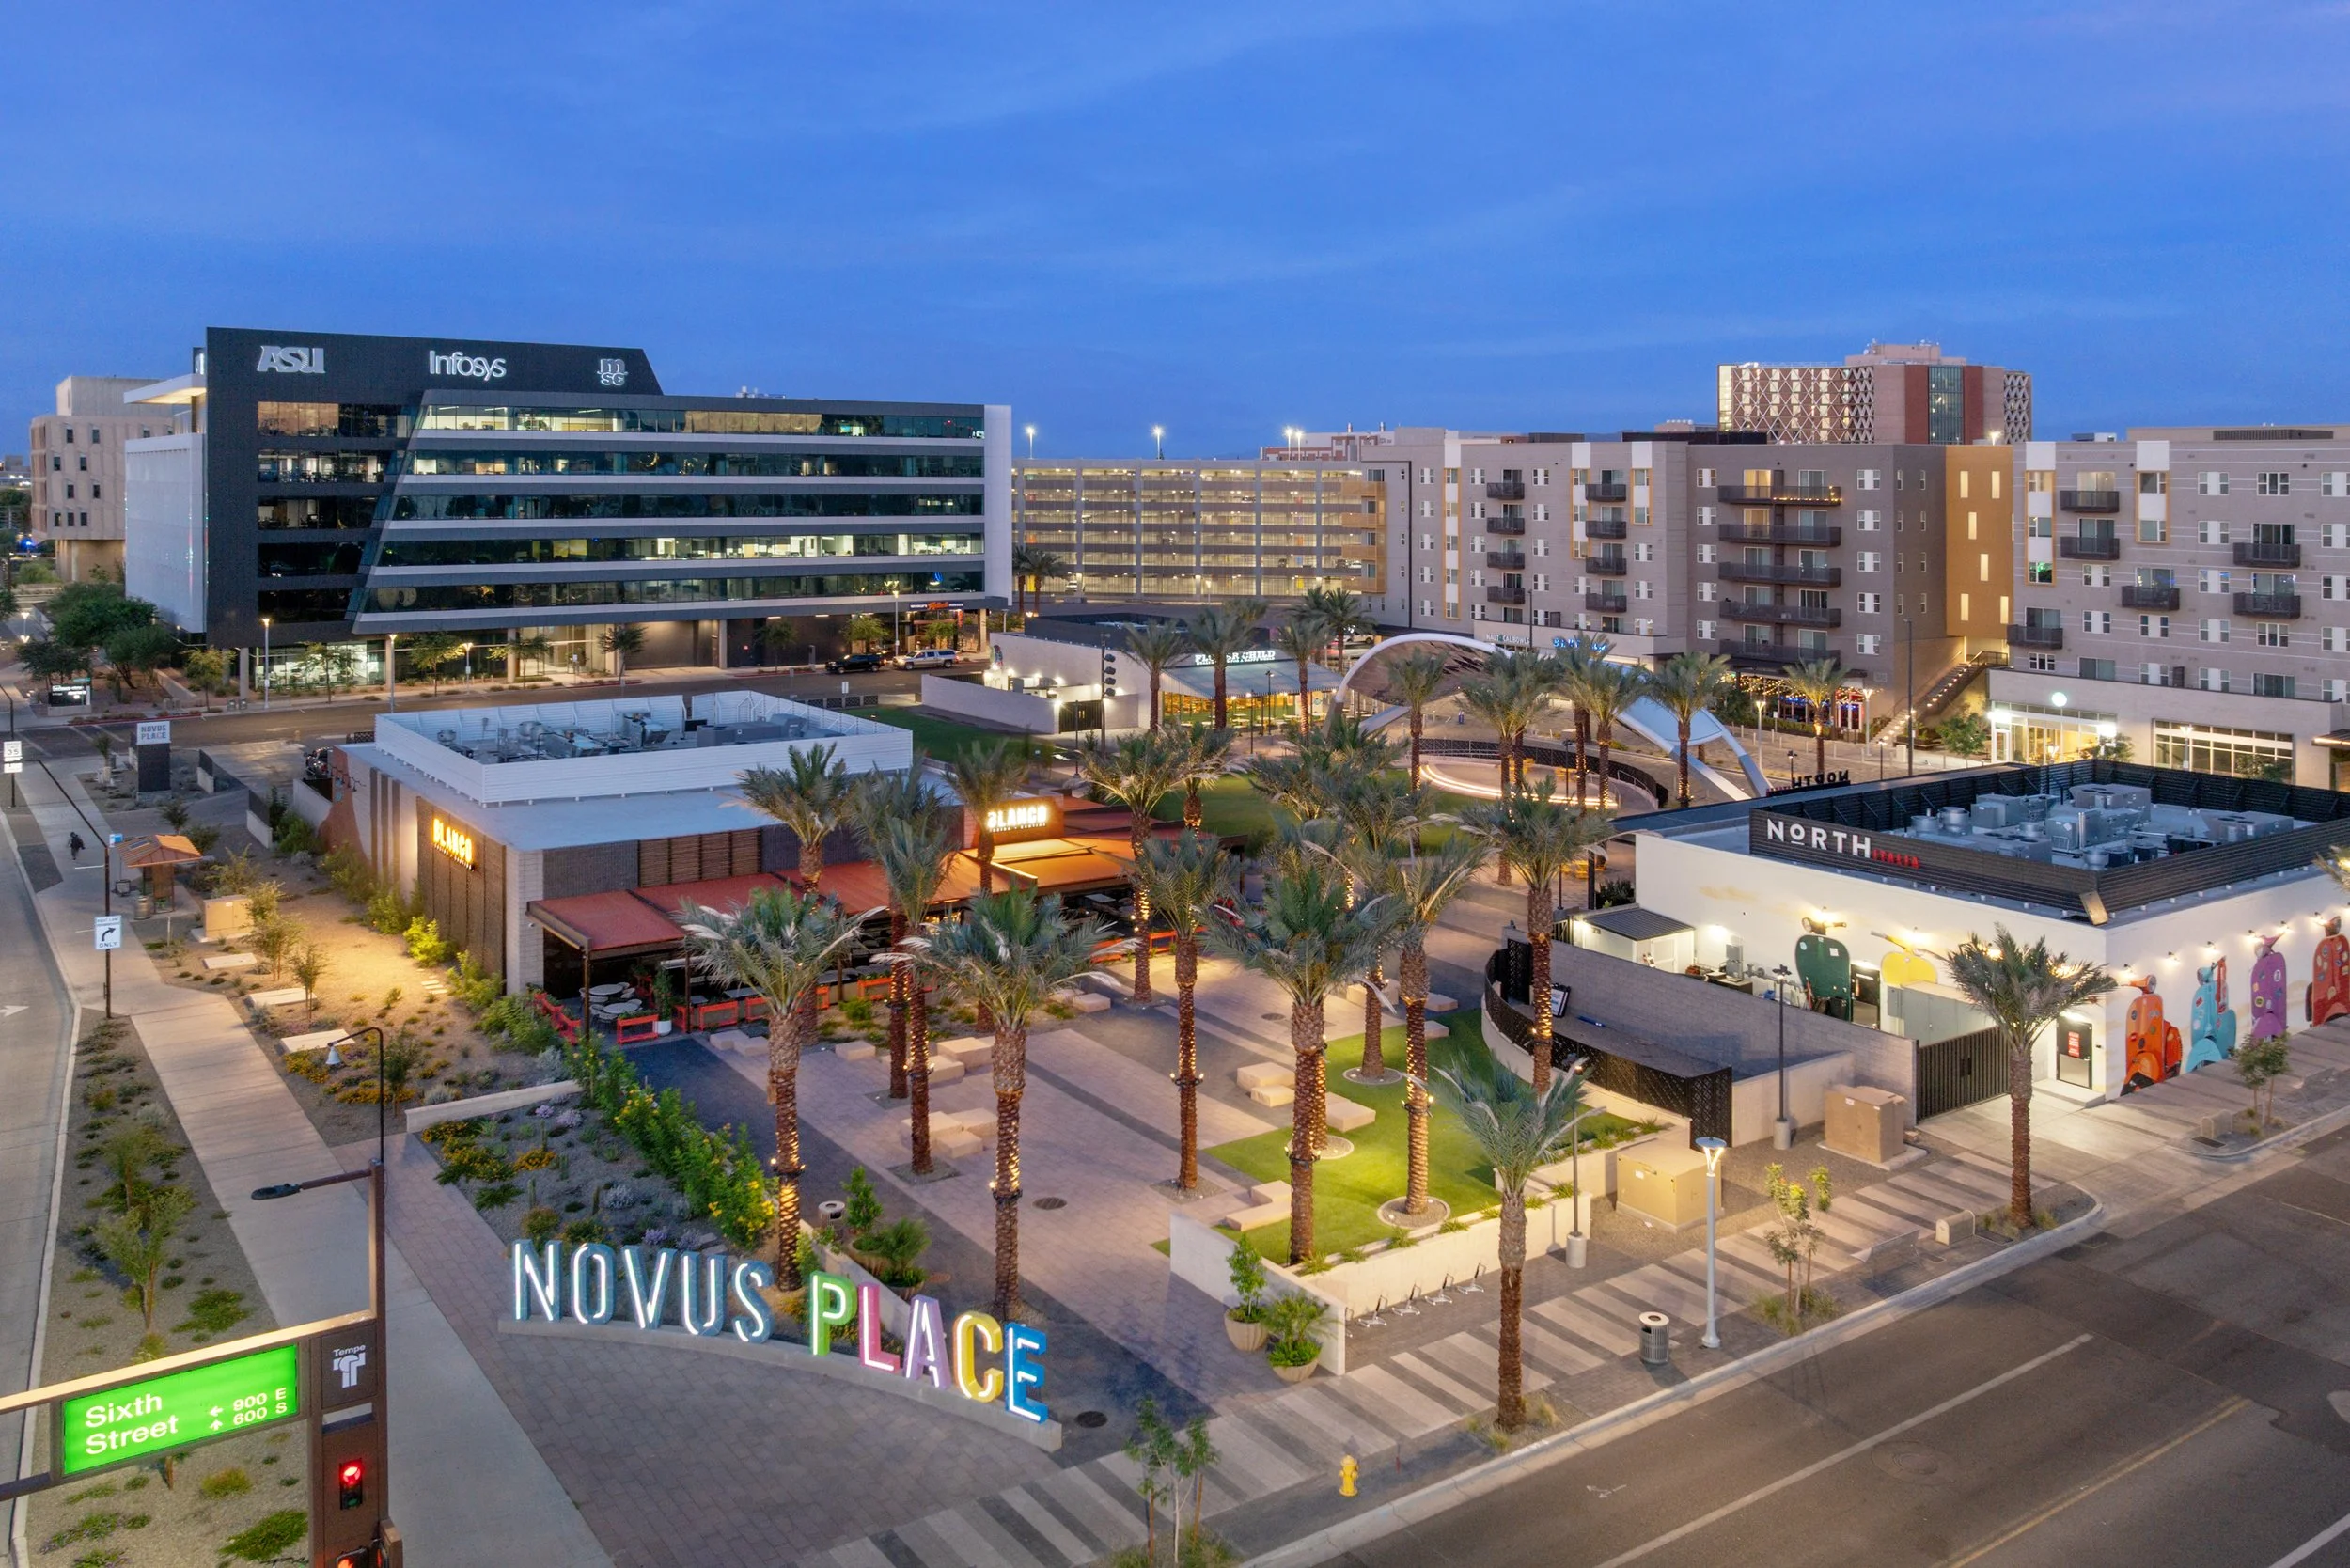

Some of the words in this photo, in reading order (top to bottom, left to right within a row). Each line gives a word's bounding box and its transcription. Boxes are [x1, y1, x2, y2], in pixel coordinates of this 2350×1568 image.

[257, 346, 326, 374] ASU
[429, 350, 507, 382] Infosys
[1486, 634, 1512, 644] NAUTCAL
[1195, 652, 1240, 663] FLOR
[1241, 651, 1276, 660] CHILD
[141, 724, 167, 732] NOVUS
[986, 805, 1048, 828] BLANCO
[433, 818, 473, 863] BLANCO
[1767, 818, 1871, 858] NORTH
[512, 1239, 776, 1344] NOVUS
[333, 1344, 366, 1356] Tempe
[809, 1270, 1049, 1425] PLACE
[86, 1393, 162, 1428] Sixth
[233, 1392, 267, 1411] 900
[275, 1387, 287, 1400] E
[233, 1406, 267, 1426] 600
[275, 1401, 288, 1415] S
[86, 1414, 179, 1455] Street
